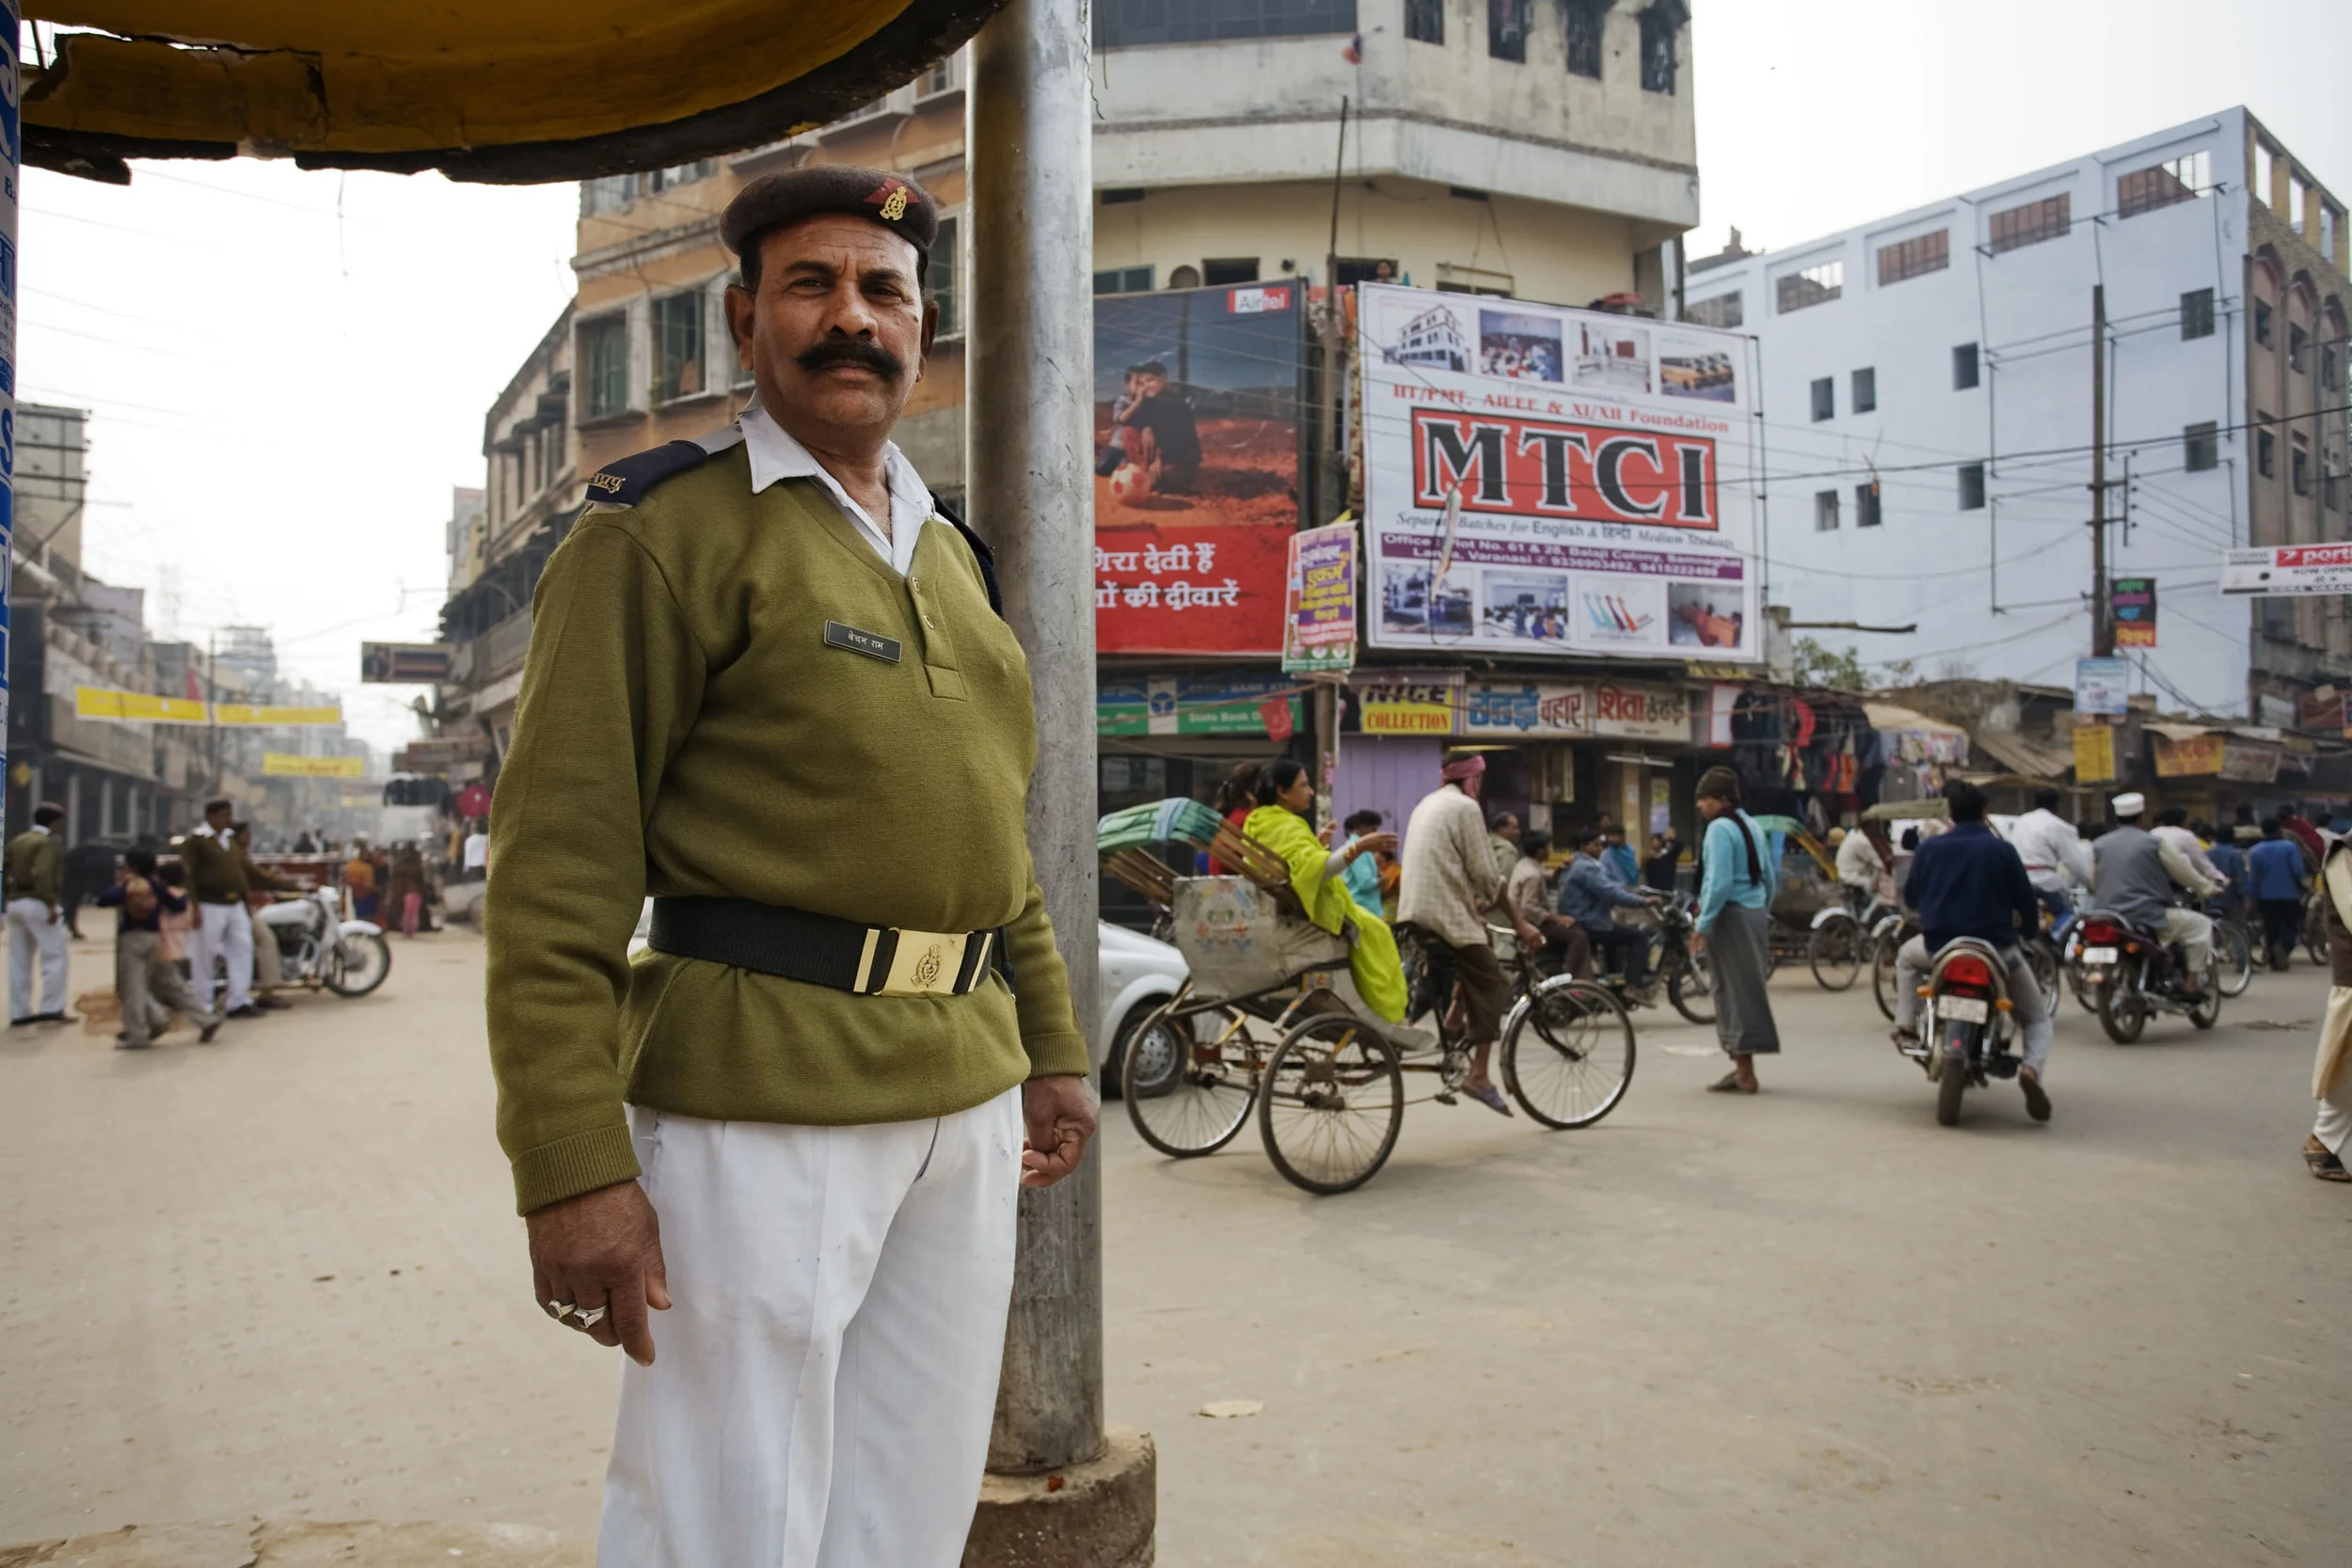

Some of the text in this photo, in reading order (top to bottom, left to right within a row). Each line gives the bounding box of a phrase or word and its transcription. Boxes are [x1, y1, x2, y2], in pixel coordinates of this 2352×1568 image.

[1629, 409, 1729, 434] Foundation
[1418, 417, 1712, 524] MTCI
[1533, 521, 1584, 539] English
[1384, 534, 1431, 546] Office
[1143, 543, 1194, 575] देती
[1468, 550, 1532, 564] Varanasi
[1123, 581, 1162, 609] की
[1165, 578, 1241, 611] दीवारें
[871, 640, 884, 651] राम
[1366, 712, 1450, 730] COLLECTION
